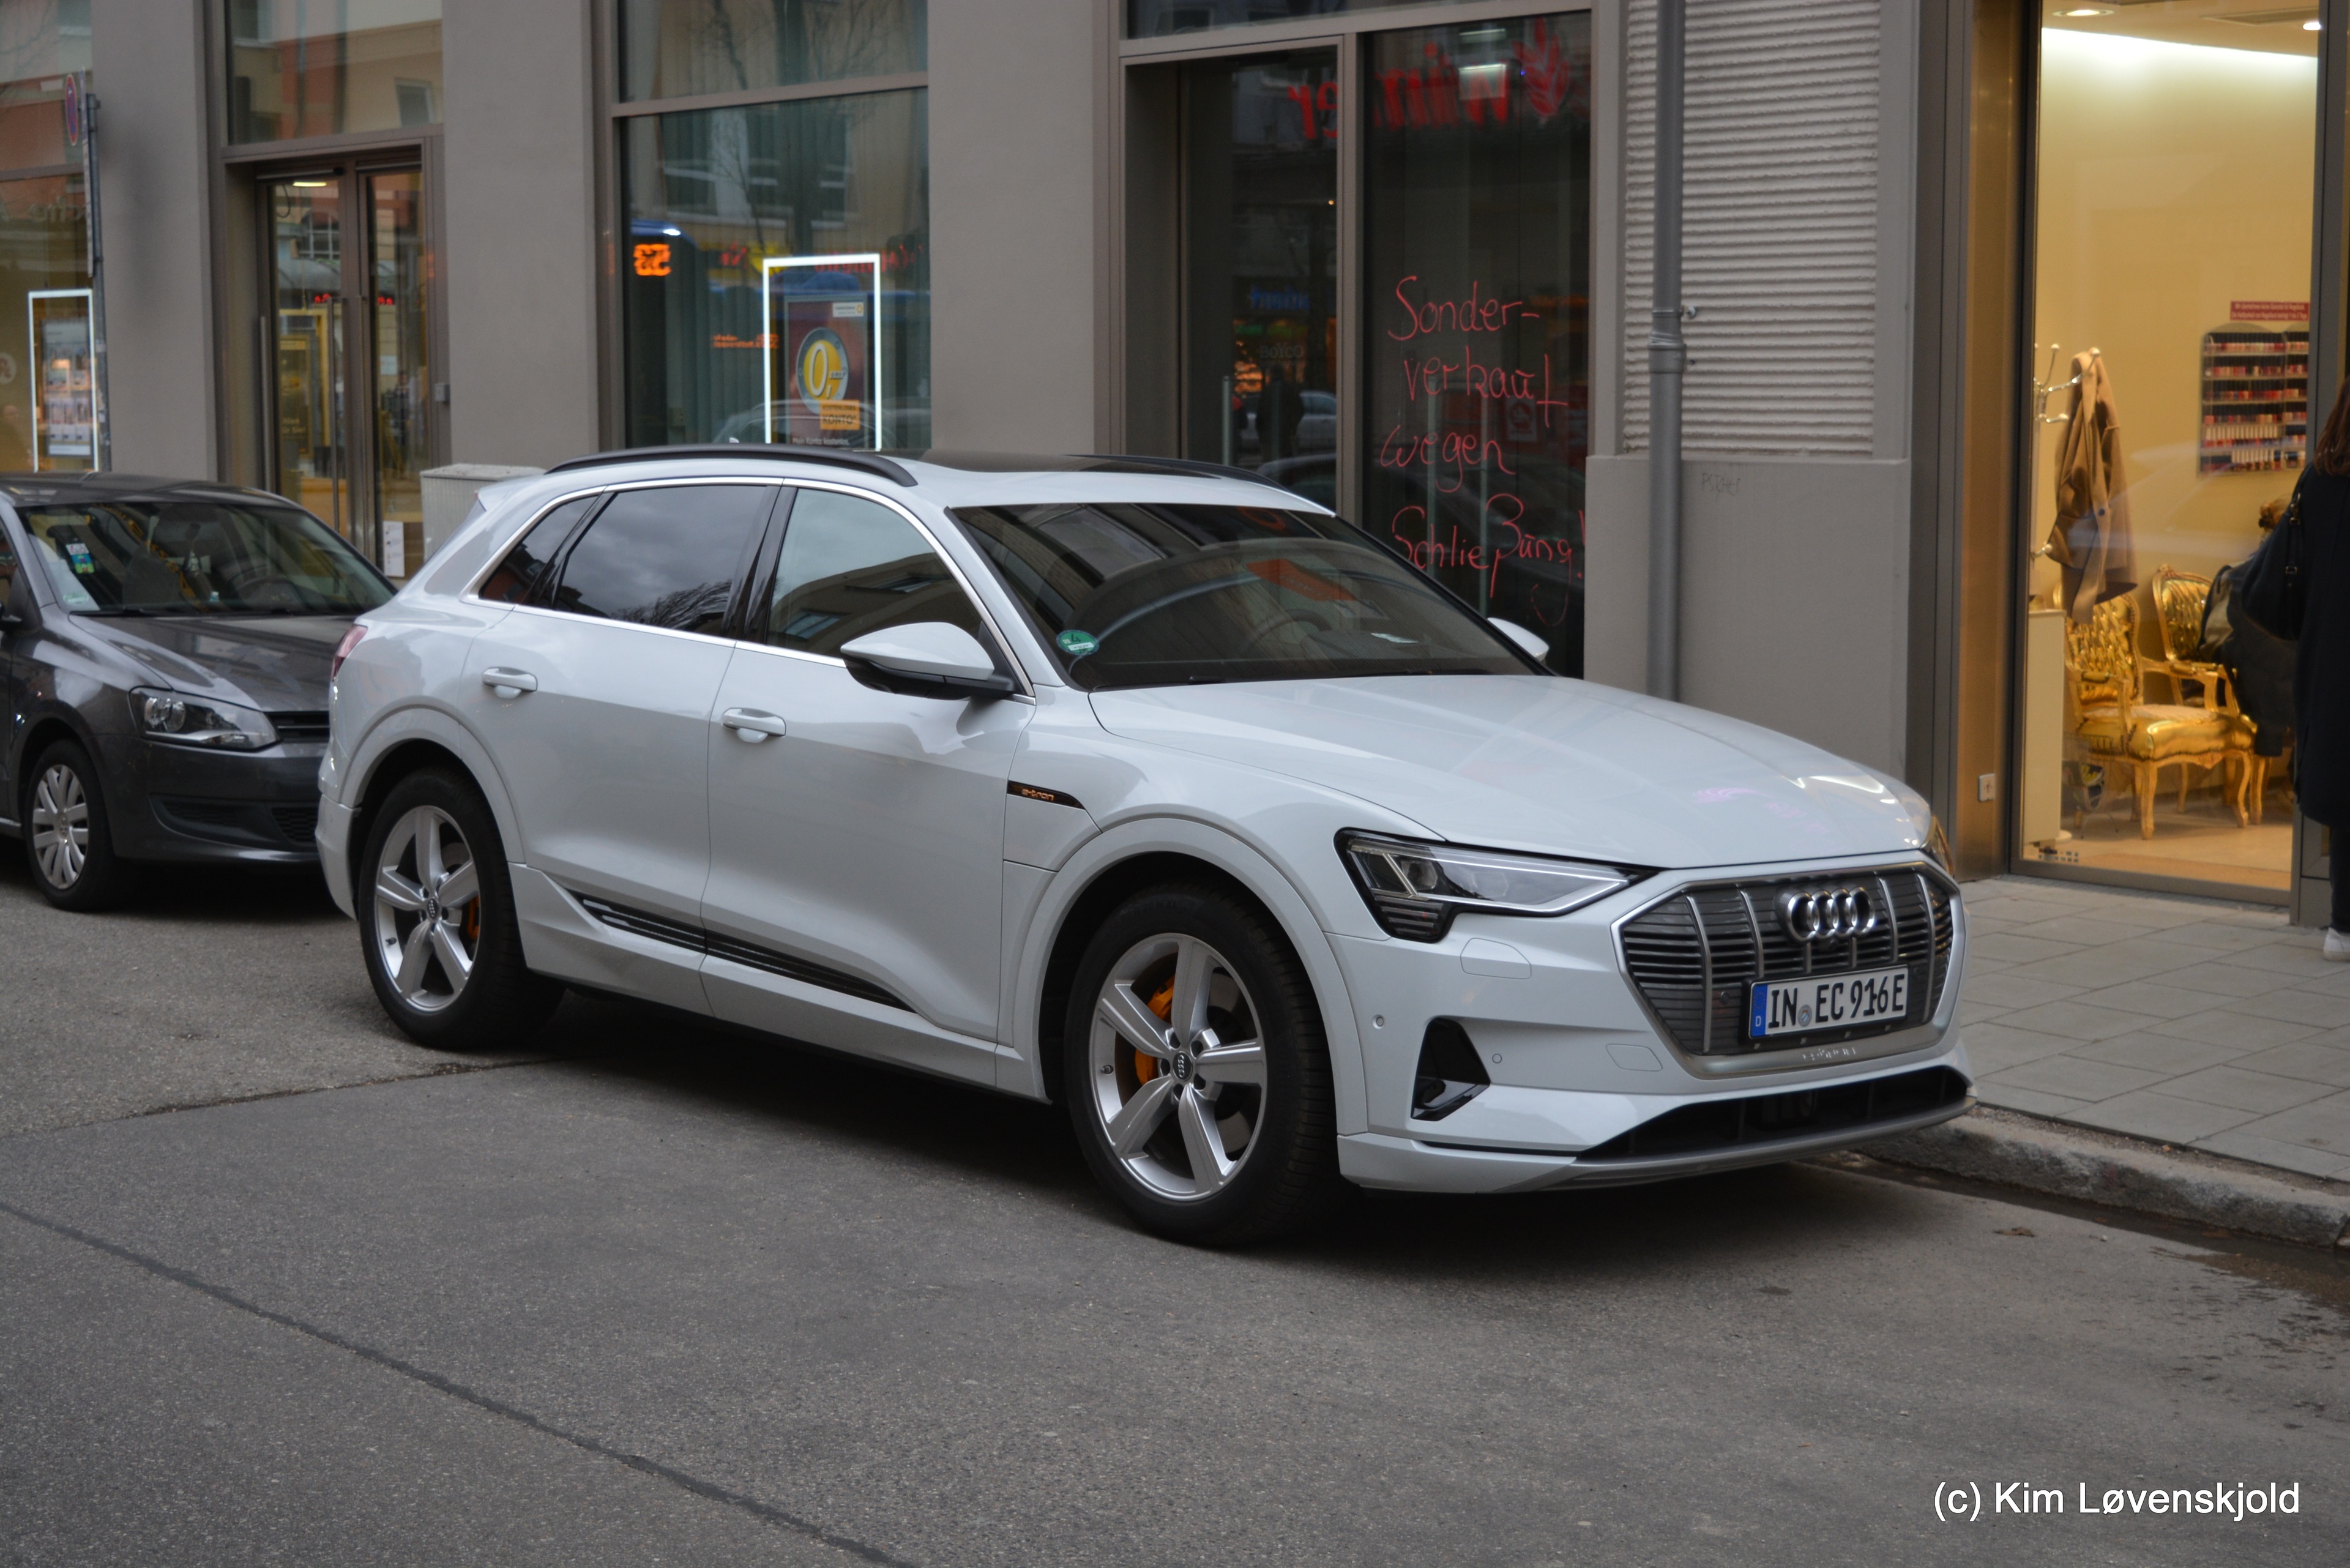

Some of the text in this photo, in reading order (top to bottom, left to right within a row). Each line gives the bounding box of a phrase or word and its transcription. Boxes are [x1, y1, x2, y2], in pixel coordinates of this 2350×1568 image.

[1387, 275, 1540, 340] Sonder-
[1380, 425, 1517, 493] wegen
[1021, 788, 1055, 801] e-tron
[1755, 973, 1906, 1029] D IN EC 916E
